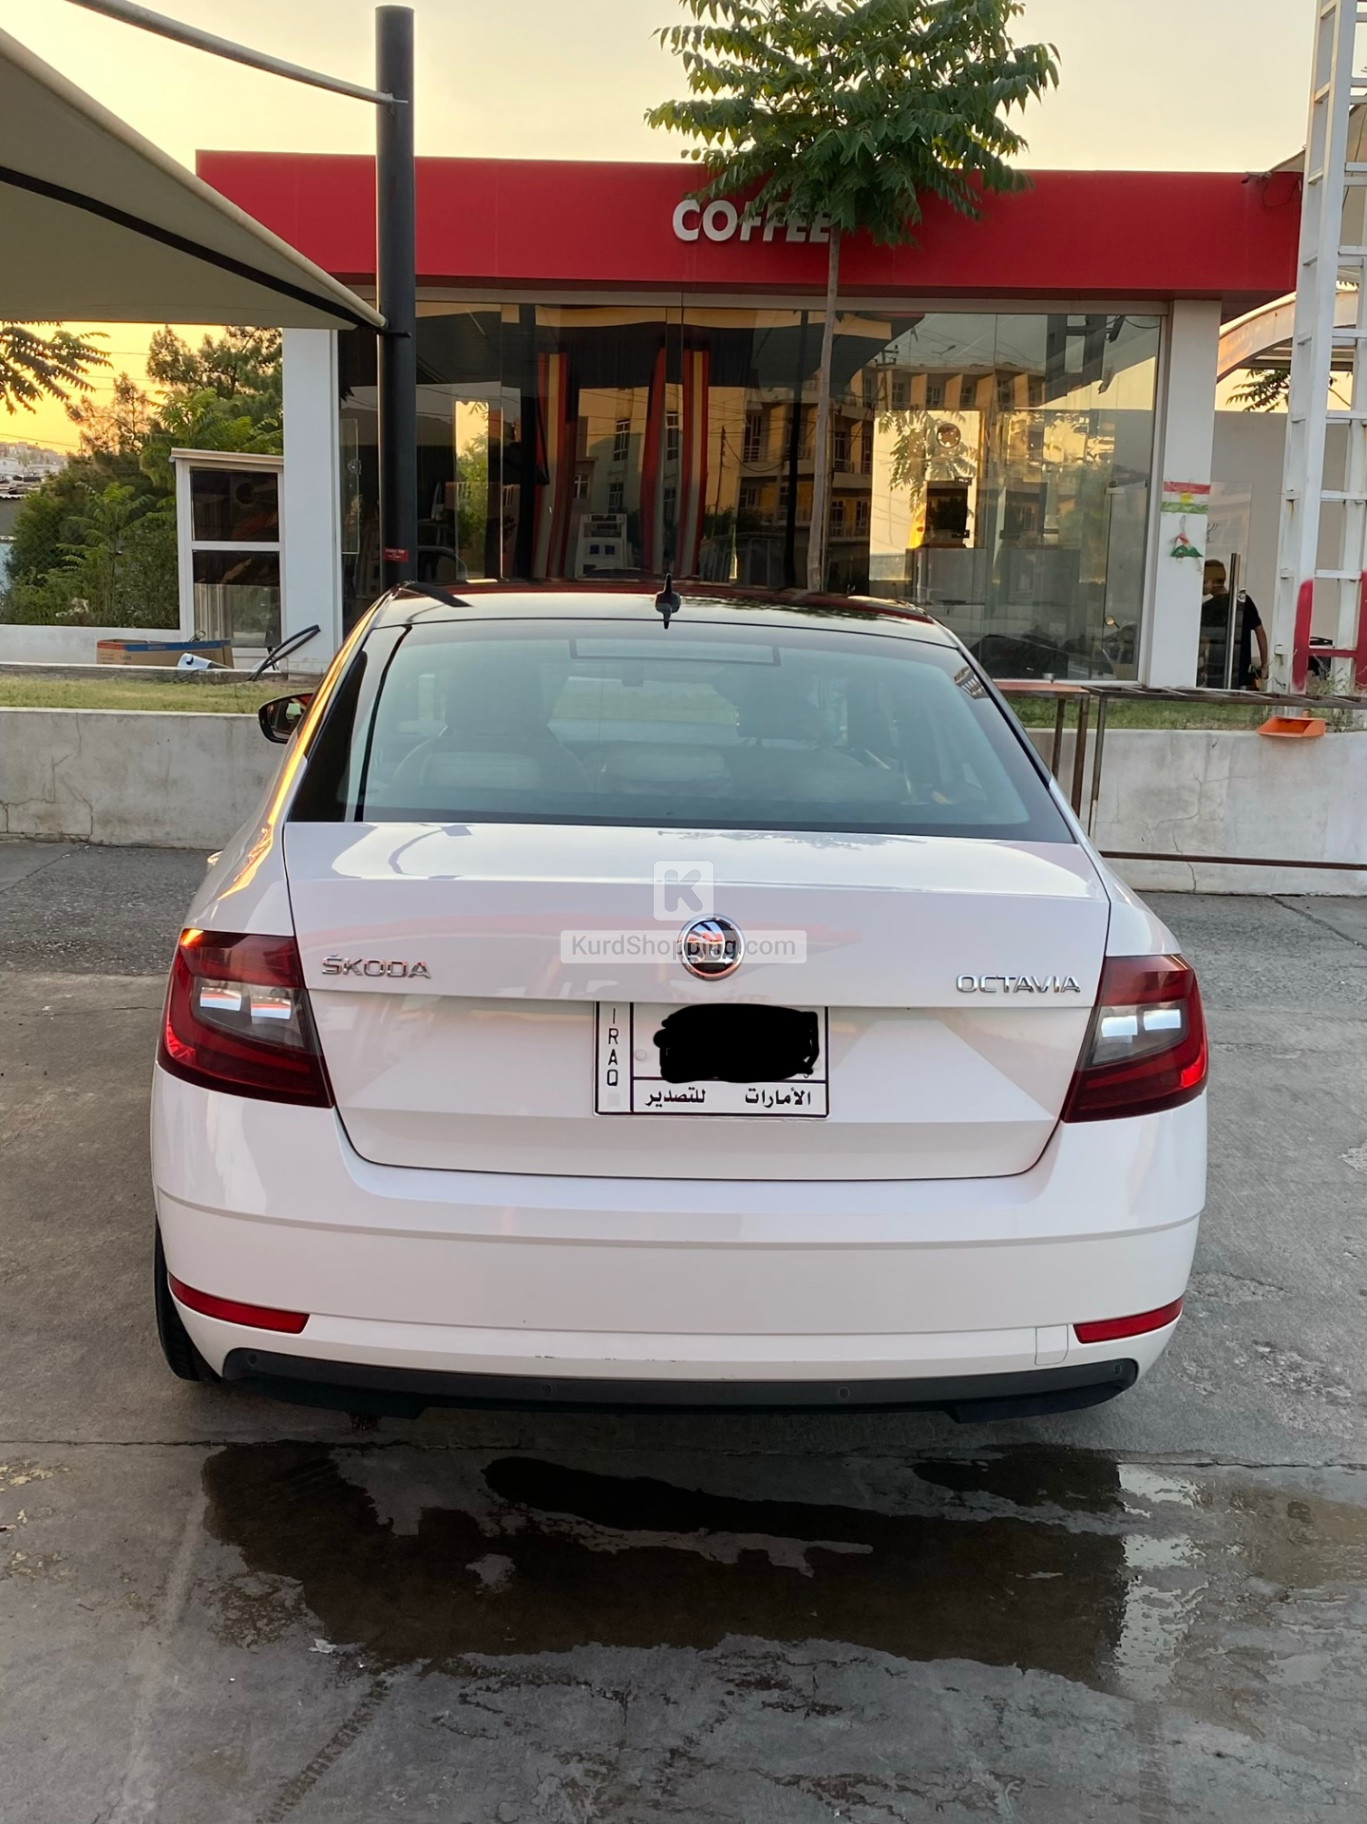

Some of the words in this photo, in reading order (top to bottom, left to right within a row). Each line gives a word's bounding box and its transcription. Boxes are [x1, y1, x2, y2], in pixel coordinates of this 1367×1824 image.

[672, 199, 832, 243] COFFEE
[321, 954, 431, 979] ŠKODA
[956, 974, 1081, 993] OCTAVIA
[606, 1007, 619, 1087] IRAQ
[644, 1086, 706, 1108] للتصدير
